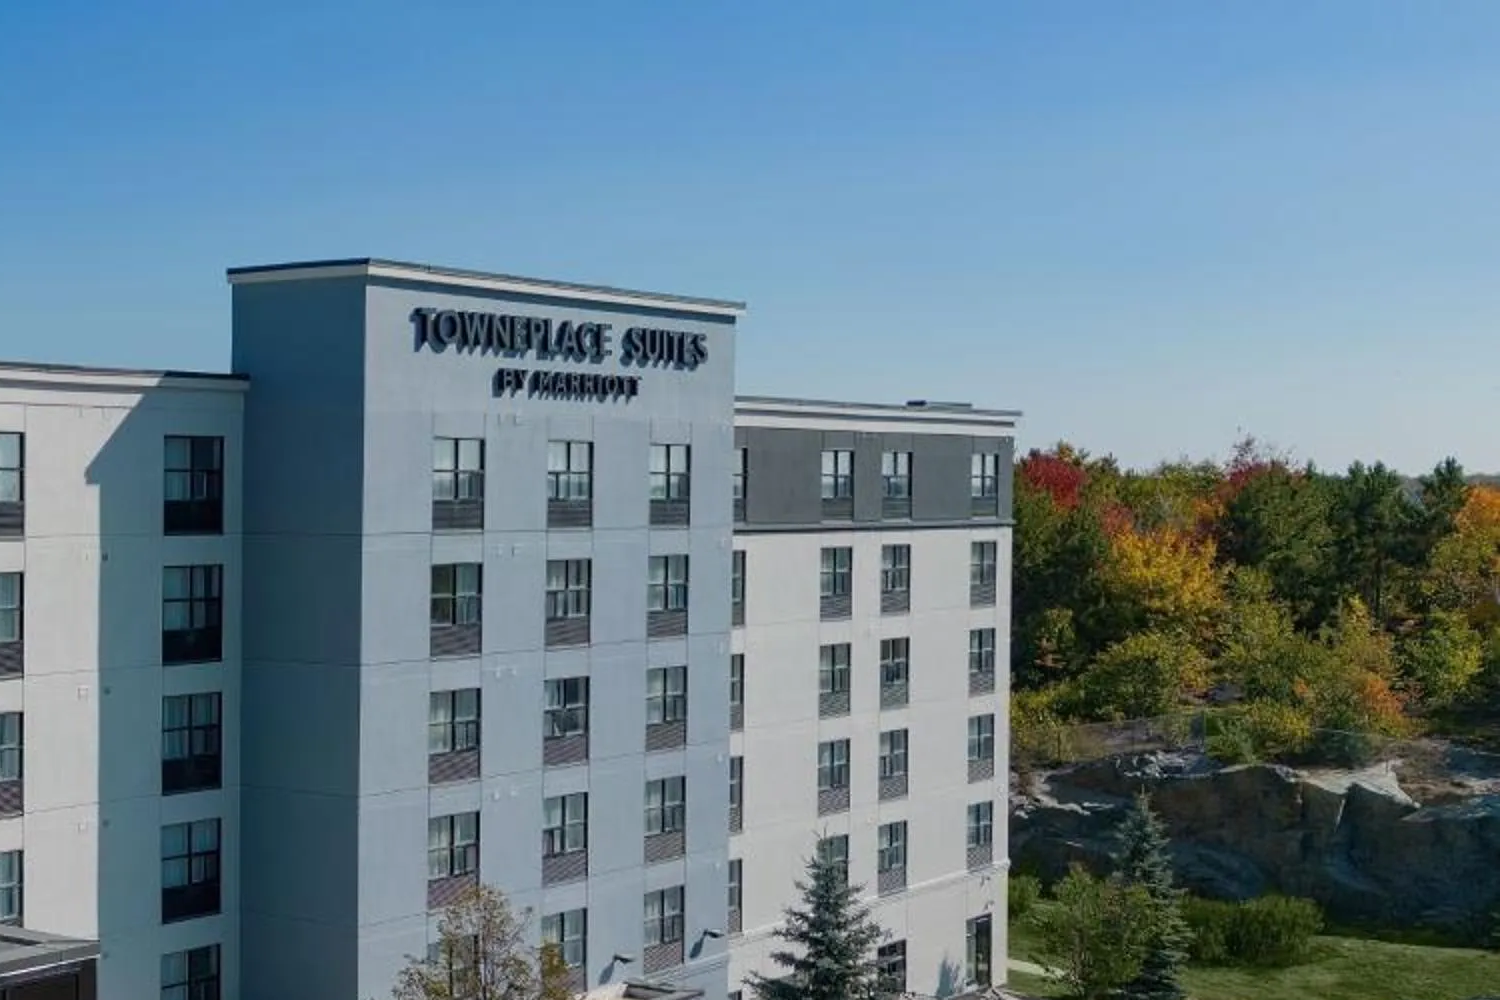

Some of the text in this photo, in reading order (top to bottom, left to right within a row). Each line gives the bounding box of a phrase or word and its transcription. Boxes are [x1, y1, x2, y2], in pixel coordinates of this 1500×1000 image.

[410, 307, 708, 369] TOWNEPLACE SUITES
[495, 367, 643, 402] BY MARRIOTT
